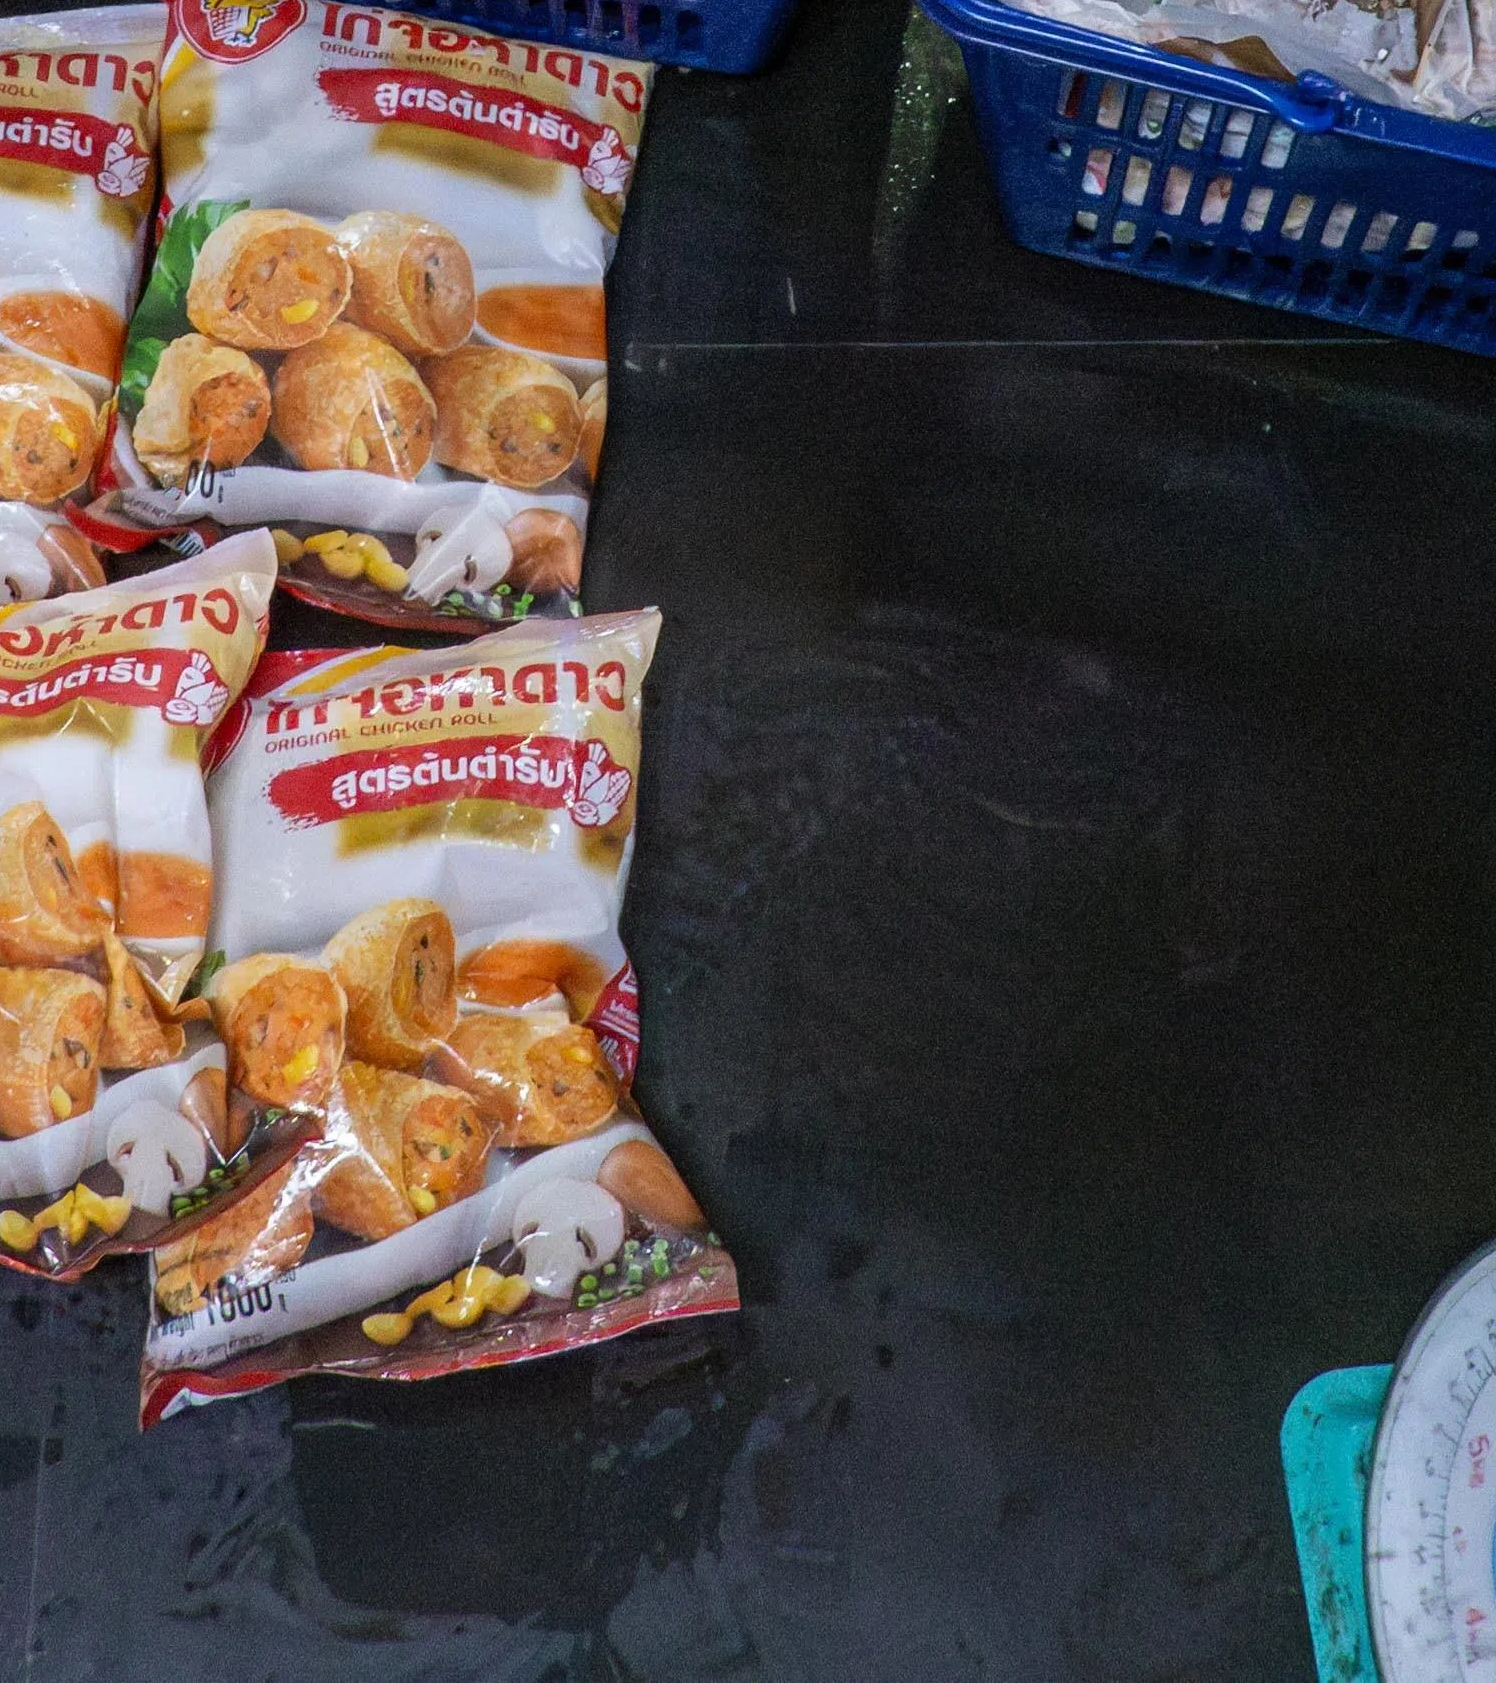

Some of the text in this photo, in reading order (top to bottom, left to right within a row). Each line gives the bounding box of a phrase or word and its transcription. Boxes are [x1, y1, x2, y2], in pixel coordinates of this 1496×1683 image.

[374, 82, 580, 151] สูตรต้นตำรับ
[265, 712, 497, 753] ORIGINAL CHICKEN ROLL
[330, 745, 566, 809] สูตรต้นตำรับ
